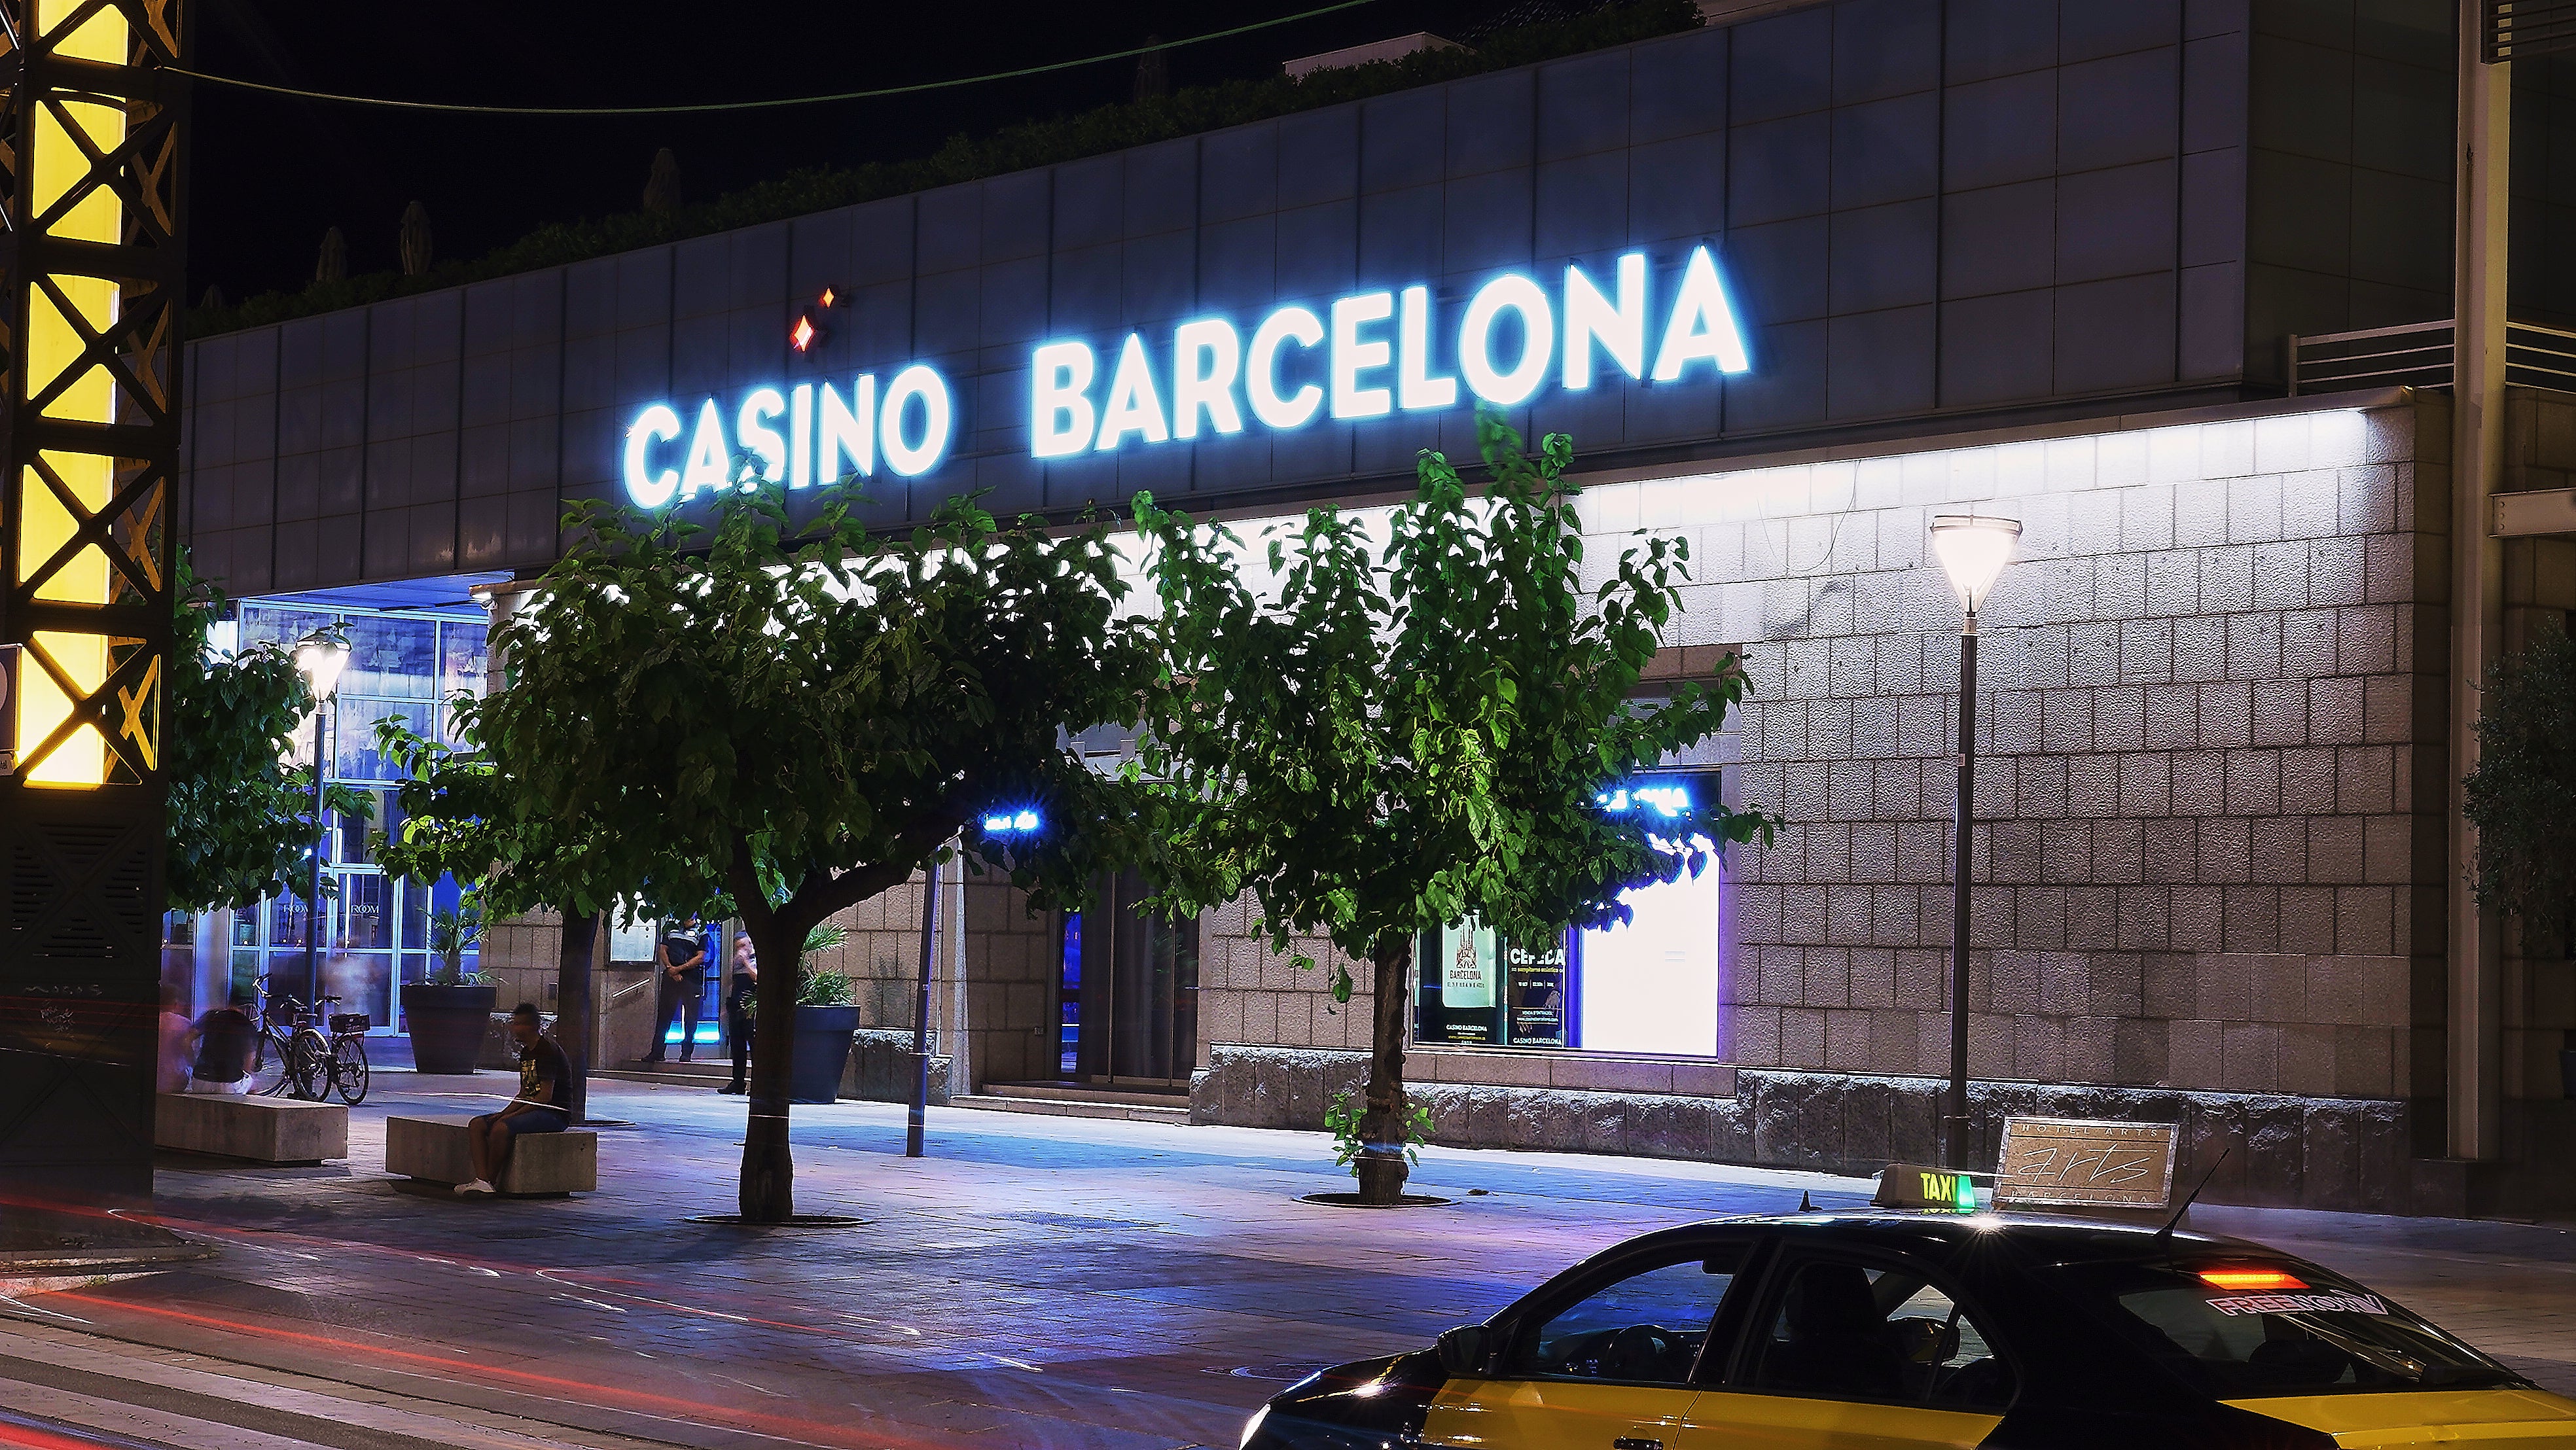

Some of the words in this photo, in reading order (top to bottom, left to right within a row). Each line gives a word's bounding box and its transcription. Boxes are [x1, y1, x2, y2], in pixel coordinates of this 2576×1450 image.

[623, 364, 949, 510] CASINO
[1031, 245, 1749, 459] BARCELONA
[351, 905, 380, 914] ROOM
[1450, 970, 1482, 980] BARCELONA
[2021, 1123, 2090, 1135] HOTEL
[2104, 1127, 2158, 1137] ARTS
[2017, 1143, 2158, 1184] arts
[1920, 1172, 1957, 1202] TAXI
